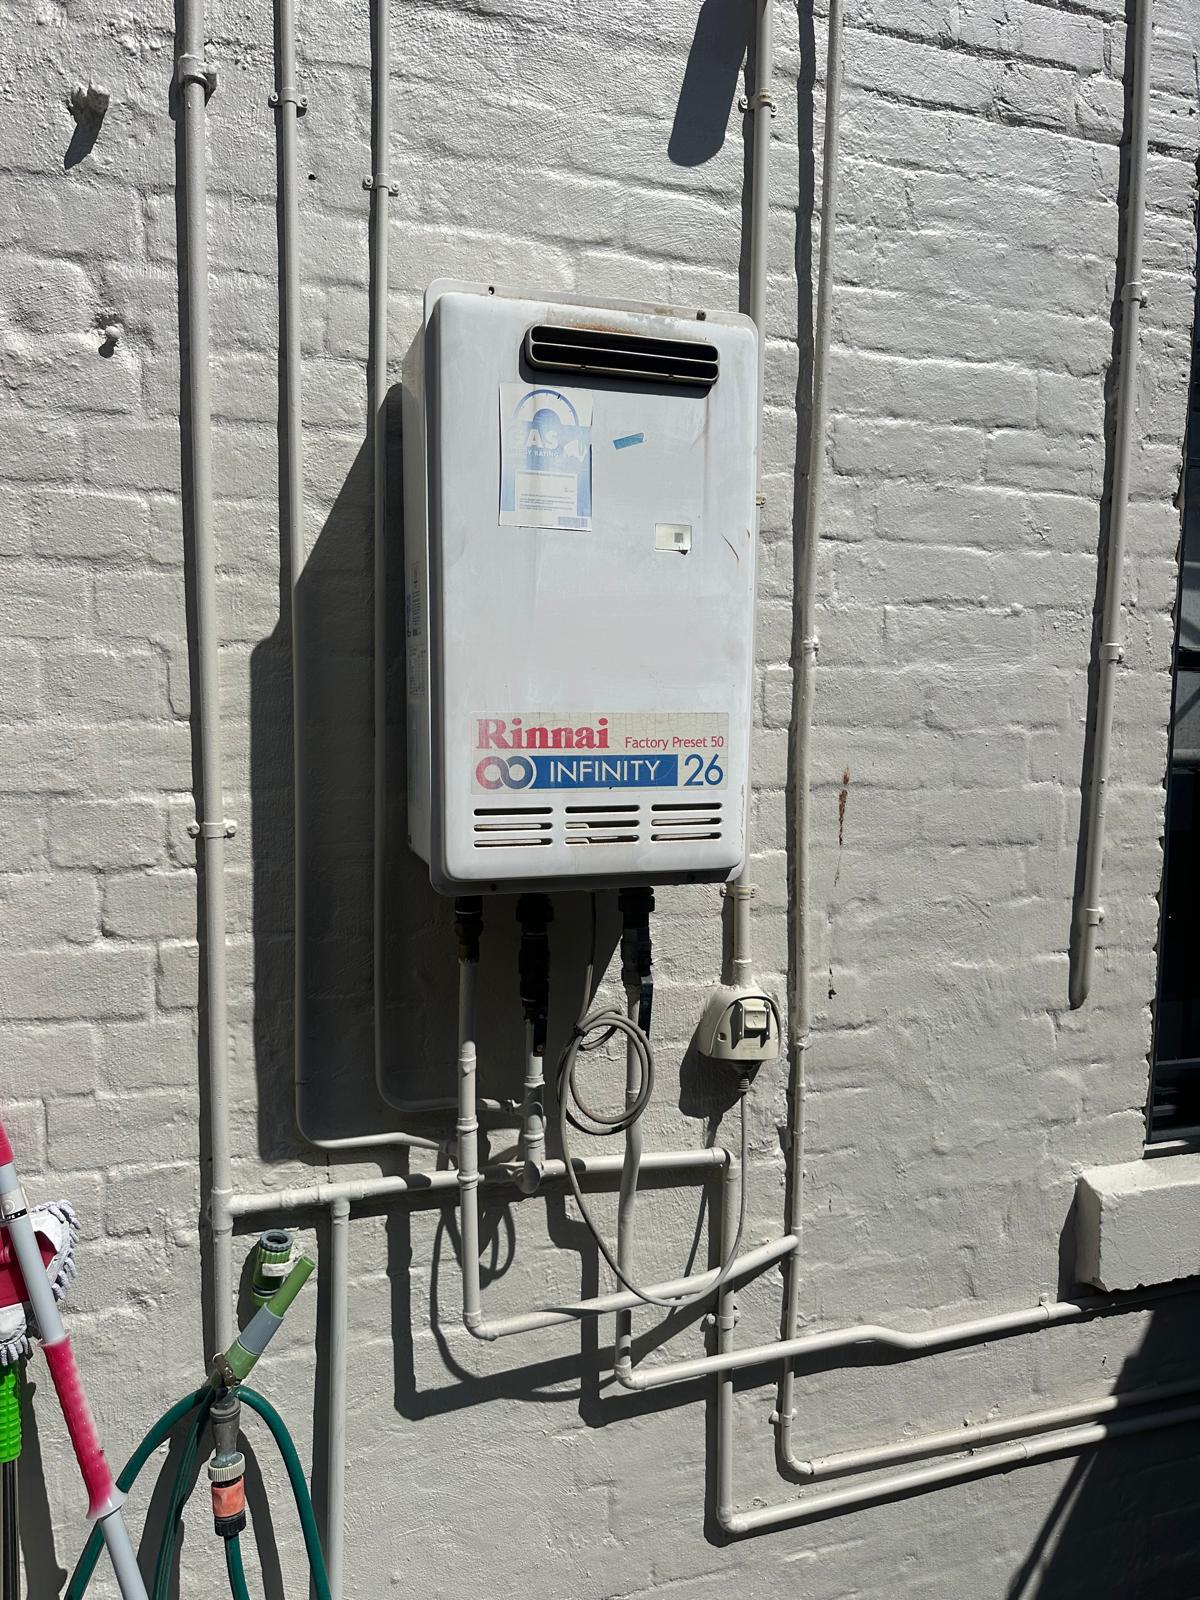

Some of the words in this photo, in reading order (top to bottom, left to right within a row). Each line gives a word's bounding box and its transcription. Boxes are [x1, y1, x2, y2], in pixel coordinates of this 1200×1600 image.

[476, 717, 610, 749] Rinnai
[625, 736, 669, 750] Factory
[672, 736, 707, 748] Preset
[711, 735, 724, 748] 50
[549, 760, 662, 783] INFINITY
[683, 753, 724, 787] 26
